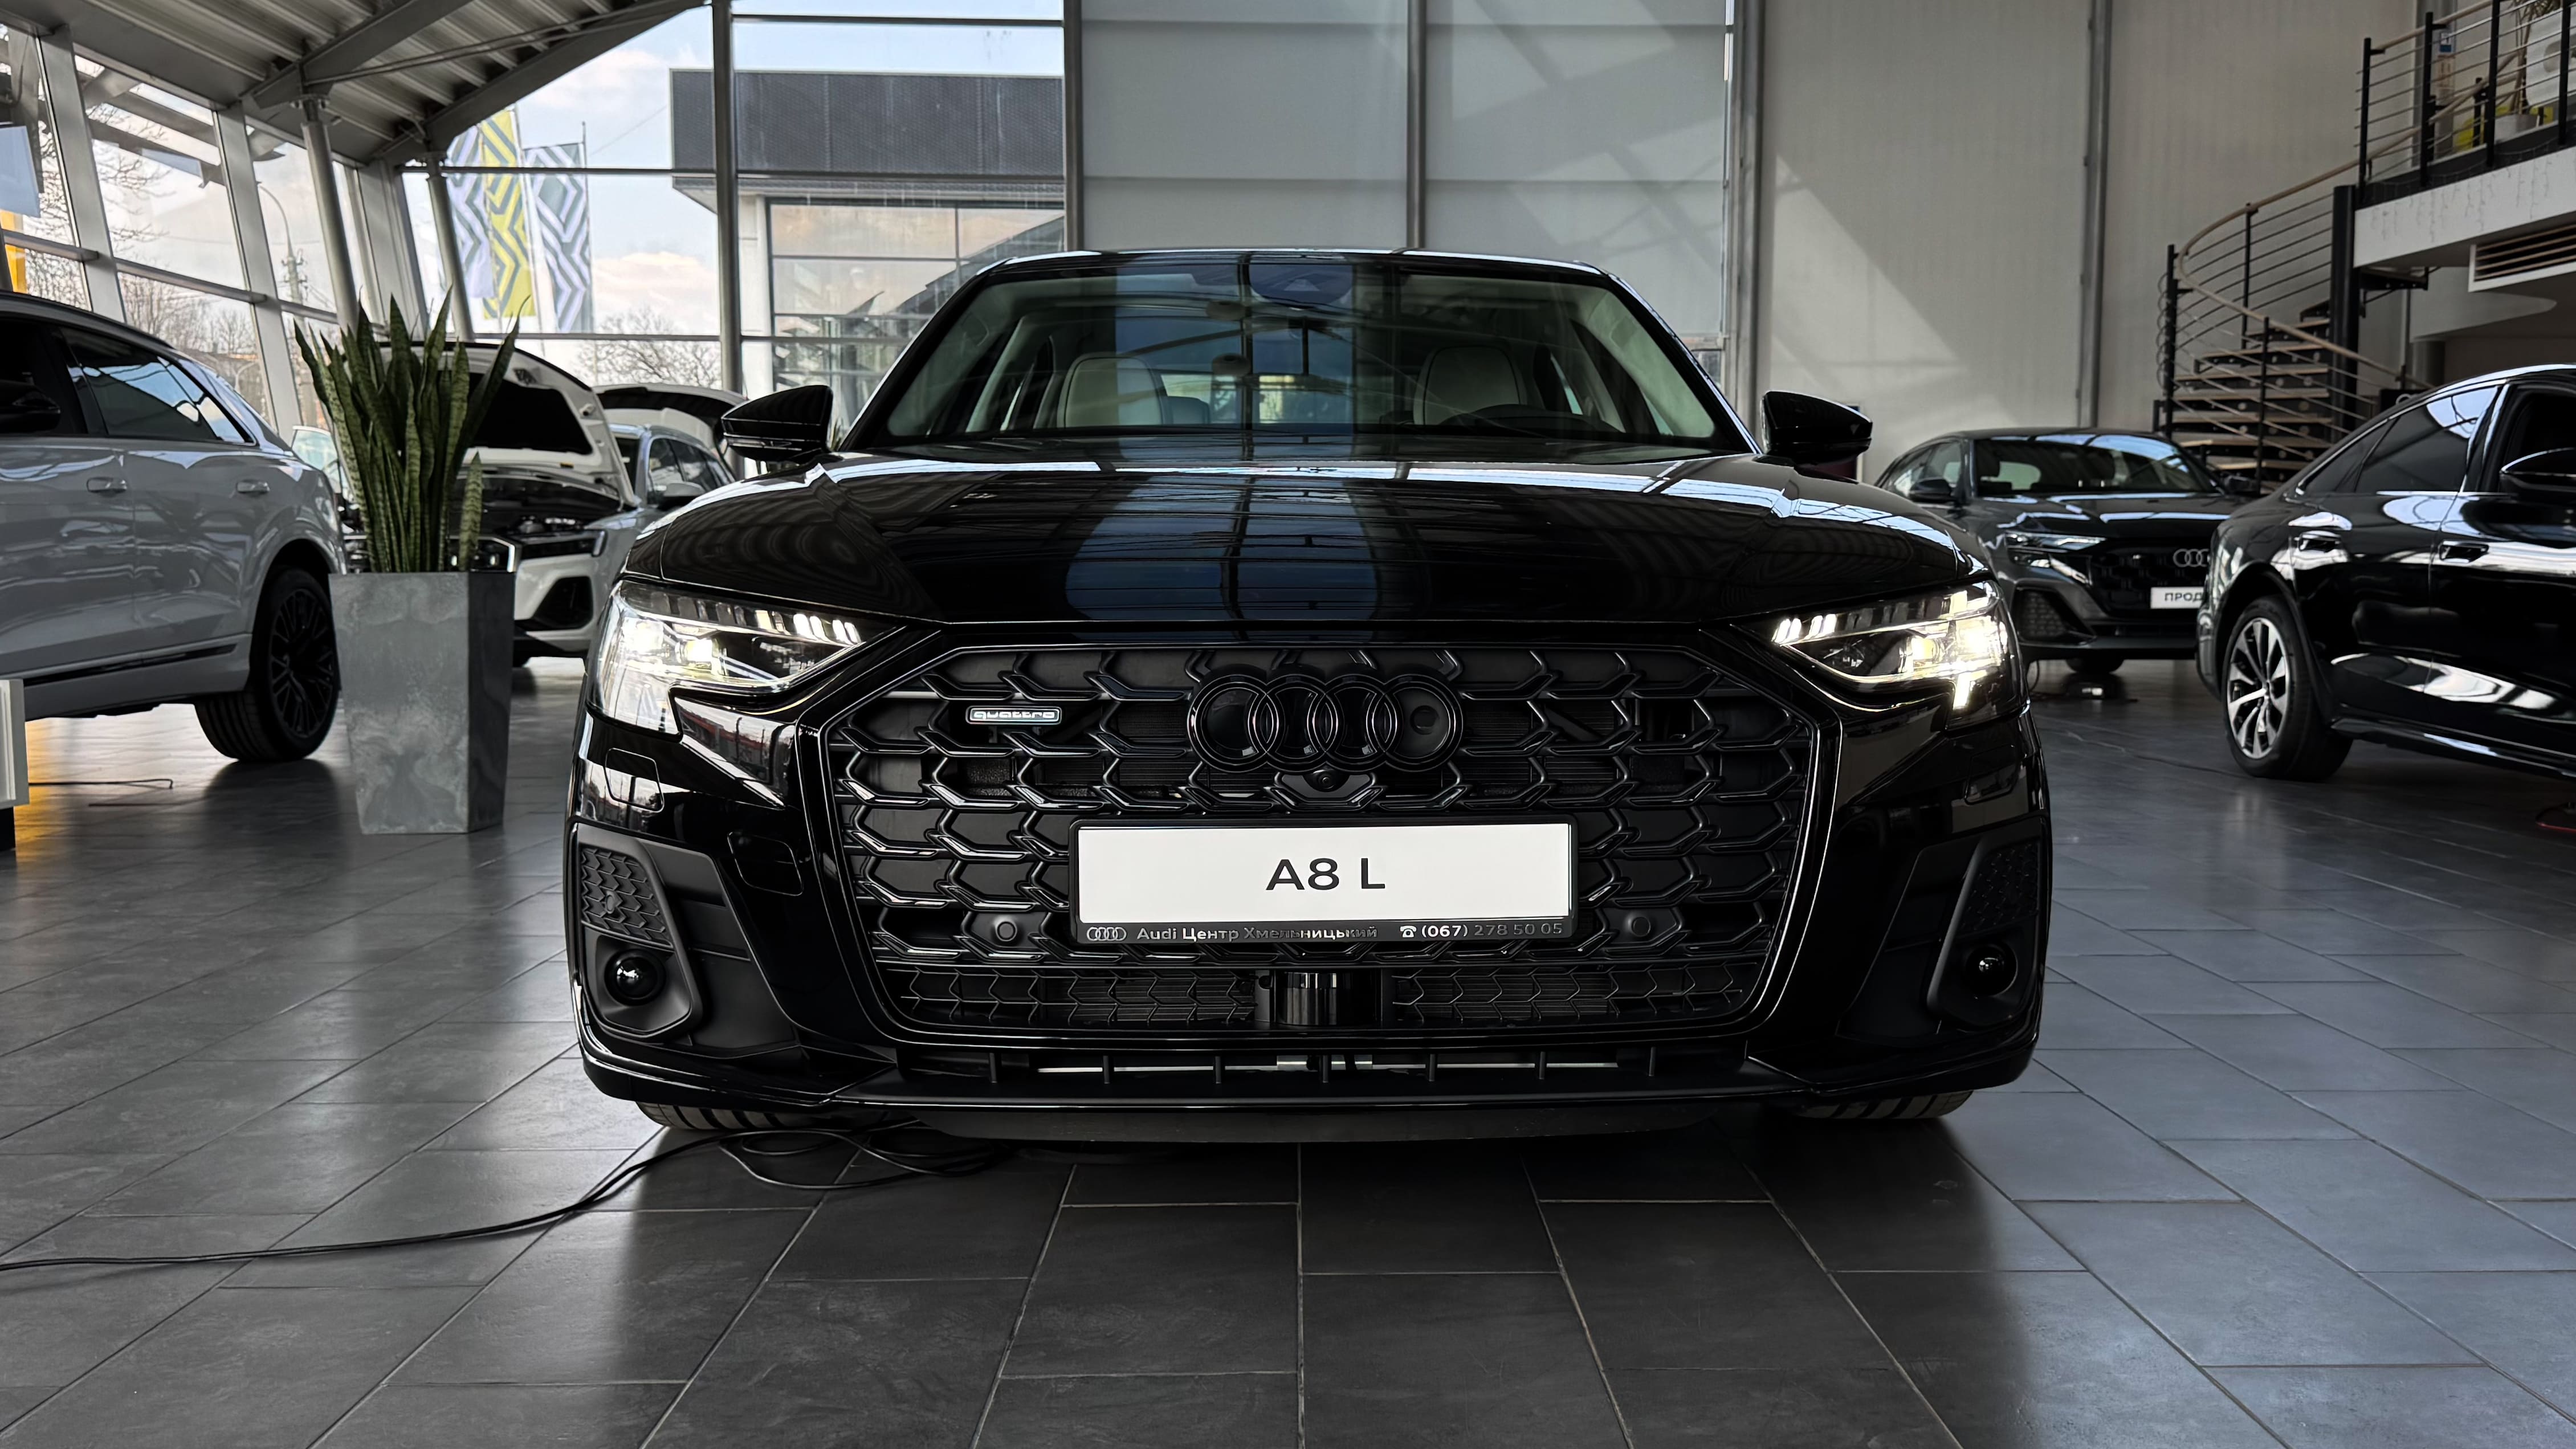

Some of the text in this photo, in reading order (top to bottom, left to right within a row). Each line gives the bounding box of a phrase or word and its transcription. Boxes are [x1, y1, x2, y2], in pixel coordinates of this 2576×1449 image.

[973, 711, 1055, 720] quattro
[1266, 858, 1385, 891] A8 L
[1137, 923, 1563, 942] Audi Центр Хмельницький (067) 278 50 05
